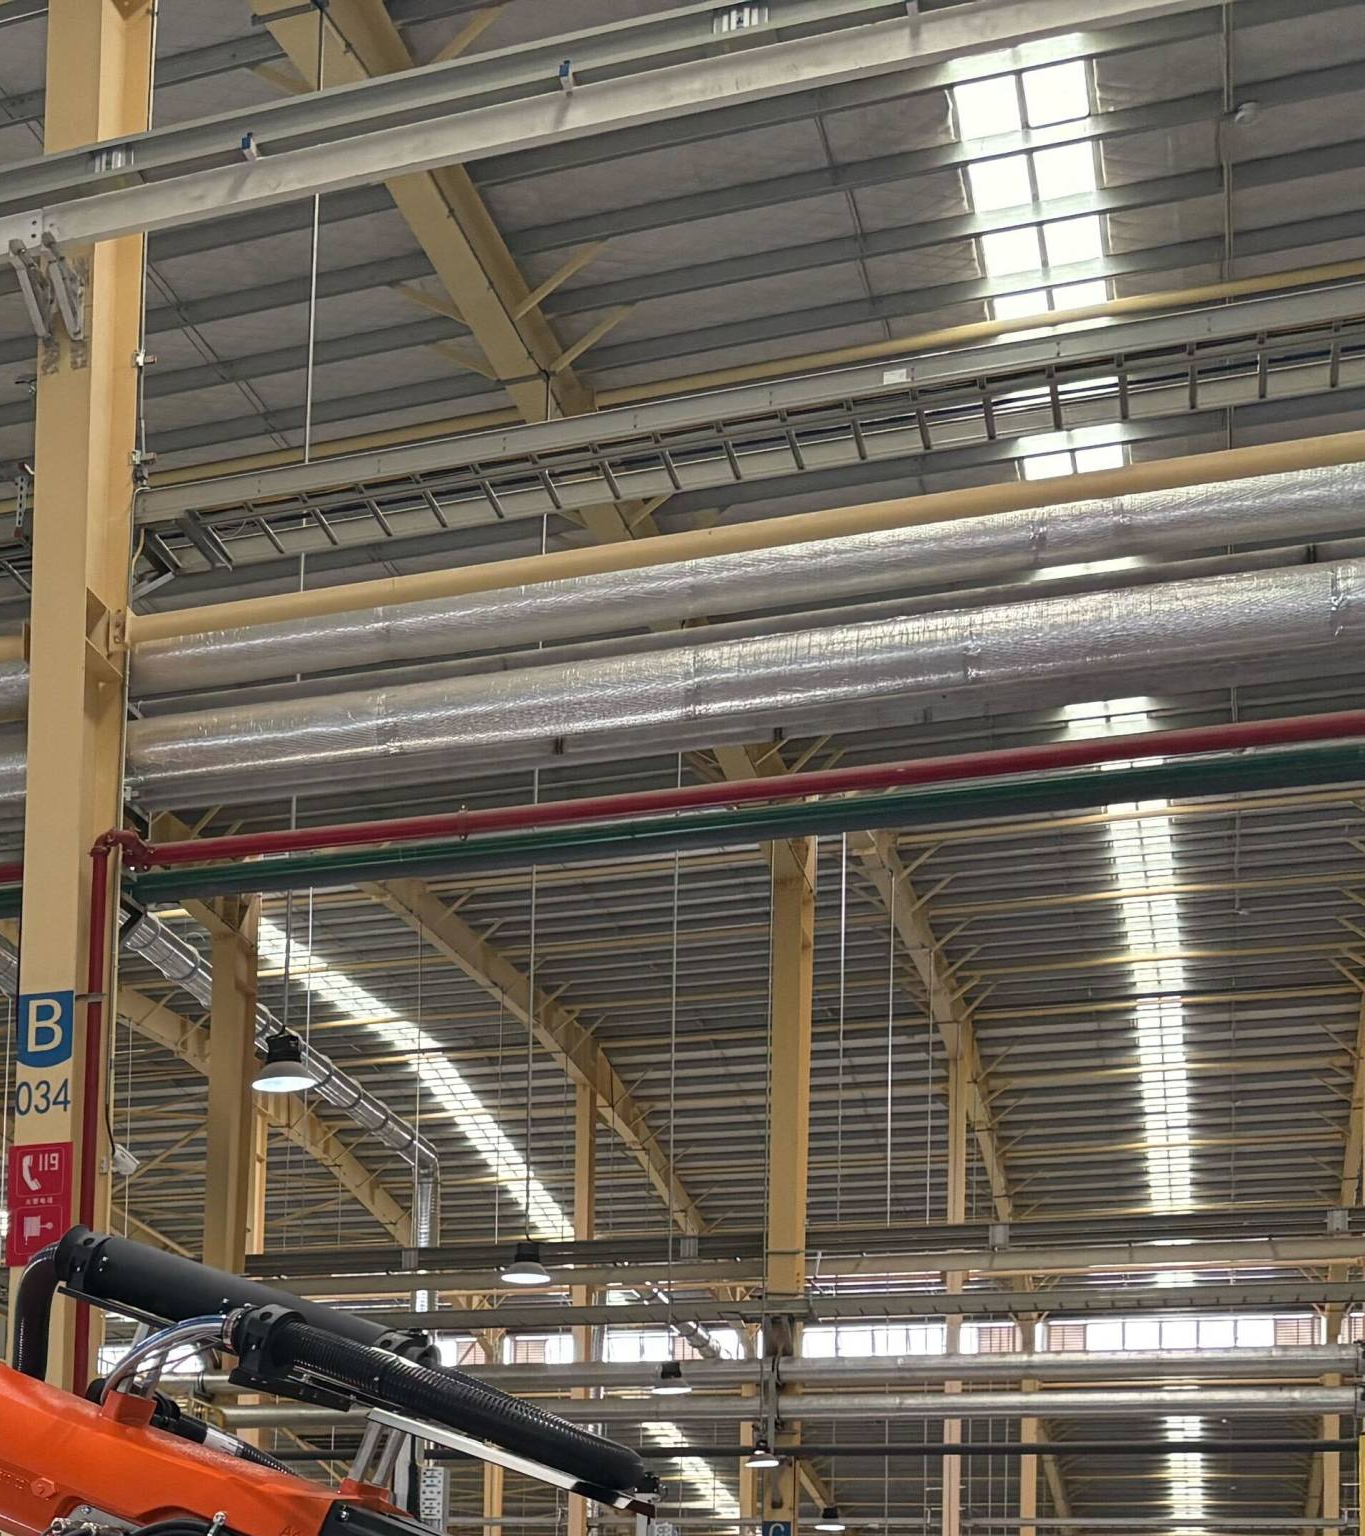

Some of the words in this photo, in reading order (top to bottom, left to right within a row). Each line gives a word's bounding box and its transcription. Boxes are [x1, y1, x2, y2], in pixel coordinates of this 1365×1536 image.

[27, 999, 62, 1052] B
[16, 1079, 70, 1115] 034
[39, 1153, 59, 1171] 119
